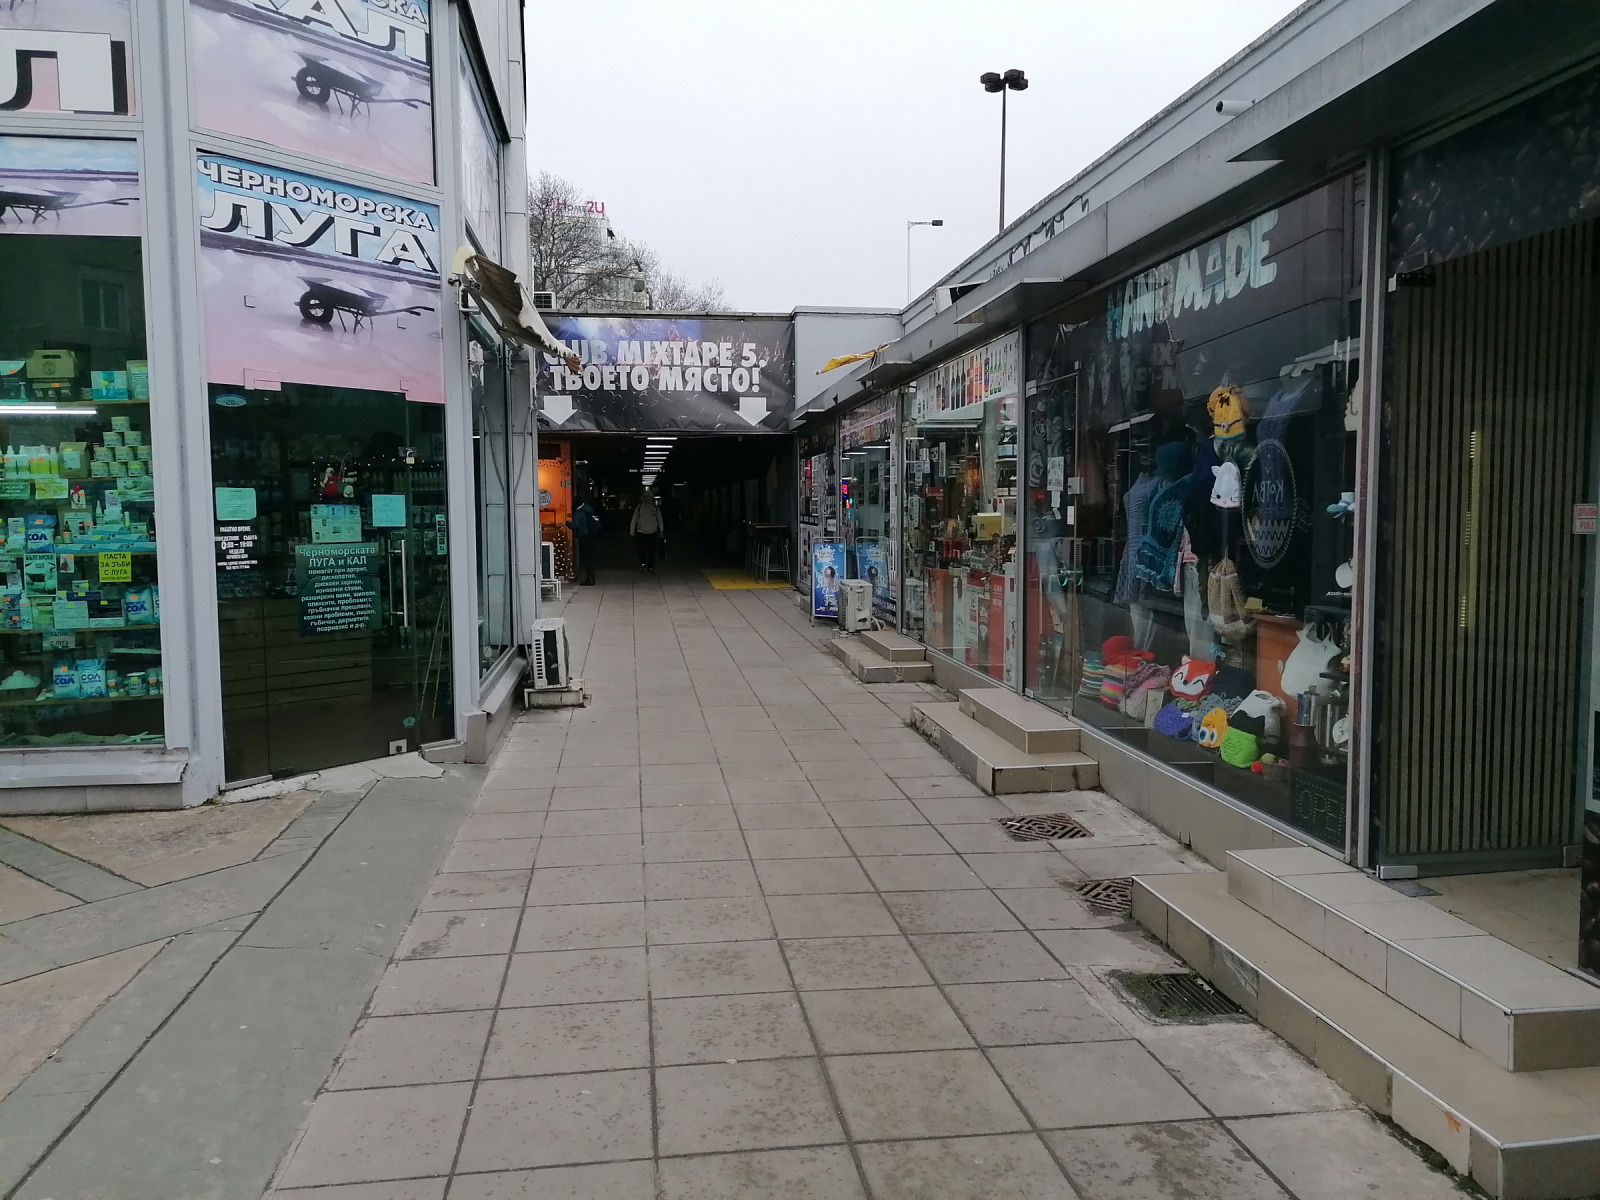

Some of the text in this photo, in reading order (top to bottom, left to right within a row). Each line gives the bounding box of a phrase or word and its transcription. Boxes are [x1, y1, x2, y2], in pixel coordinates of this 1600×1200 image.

[197, 159, 435, 232] ЧЕРНОМОРСКА
[200, 189, 438, 273] ЛУГА
[1107, 208, 1278, 343] HANDMADE
[617, 340, 732, 367] MIXTAPE
[550, 365, 760, 393] ТВОЕТО МЯСТО!
[1579, 521, 1594, 530] PULL
[299, 547, 375, 558] Черноморската
[308, 557, 336, 568] ЛУГА
[346, 556, 367, 565] КАЛ
